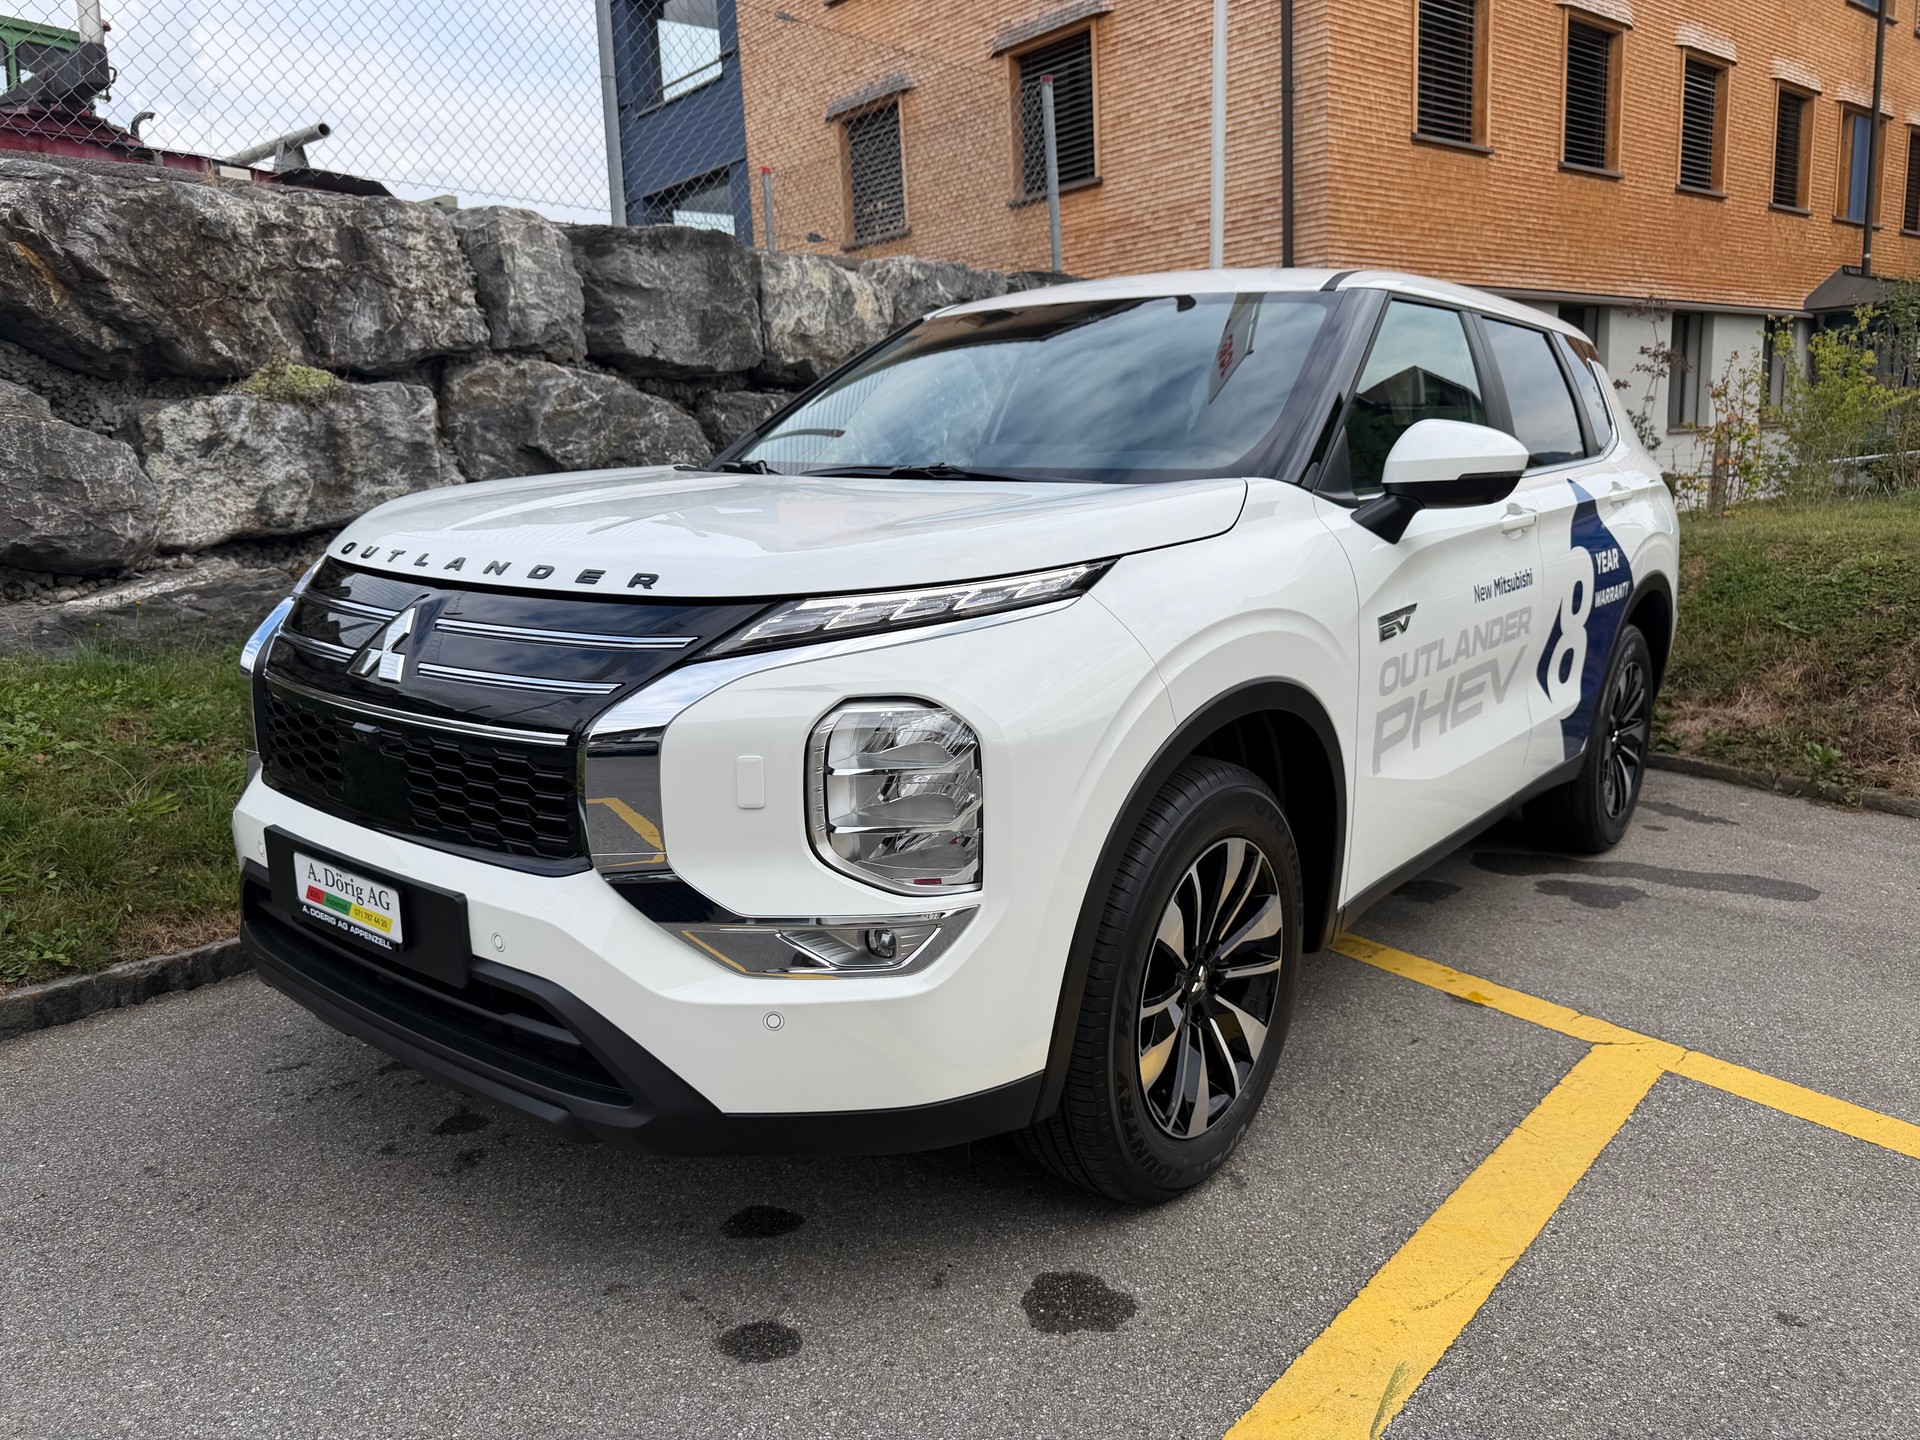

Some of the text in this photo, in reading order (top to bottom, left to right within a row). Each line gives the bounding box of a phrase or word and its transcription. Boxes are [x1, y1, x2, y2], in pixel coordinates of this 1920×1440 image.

[340, 541, 660, 590] OUTLANDER
[1595, 547, 1620, 575] YEAR
[1473, 567, 1534, 604] New Mitsubishi
[1594, 580, 1630, 609] WARRANTY
[1378, 612, 1412, 644] EV
[1379, 605, 1532, 697] OUTLANDER
[1546, 545, 1595, 720] 8
[1372, 643, 1528, 776] PHEV
[308, 863, 390, 910] A. Dörig AG
[302, 905, 392, 950] A. DOERIG AG APPENZELL
